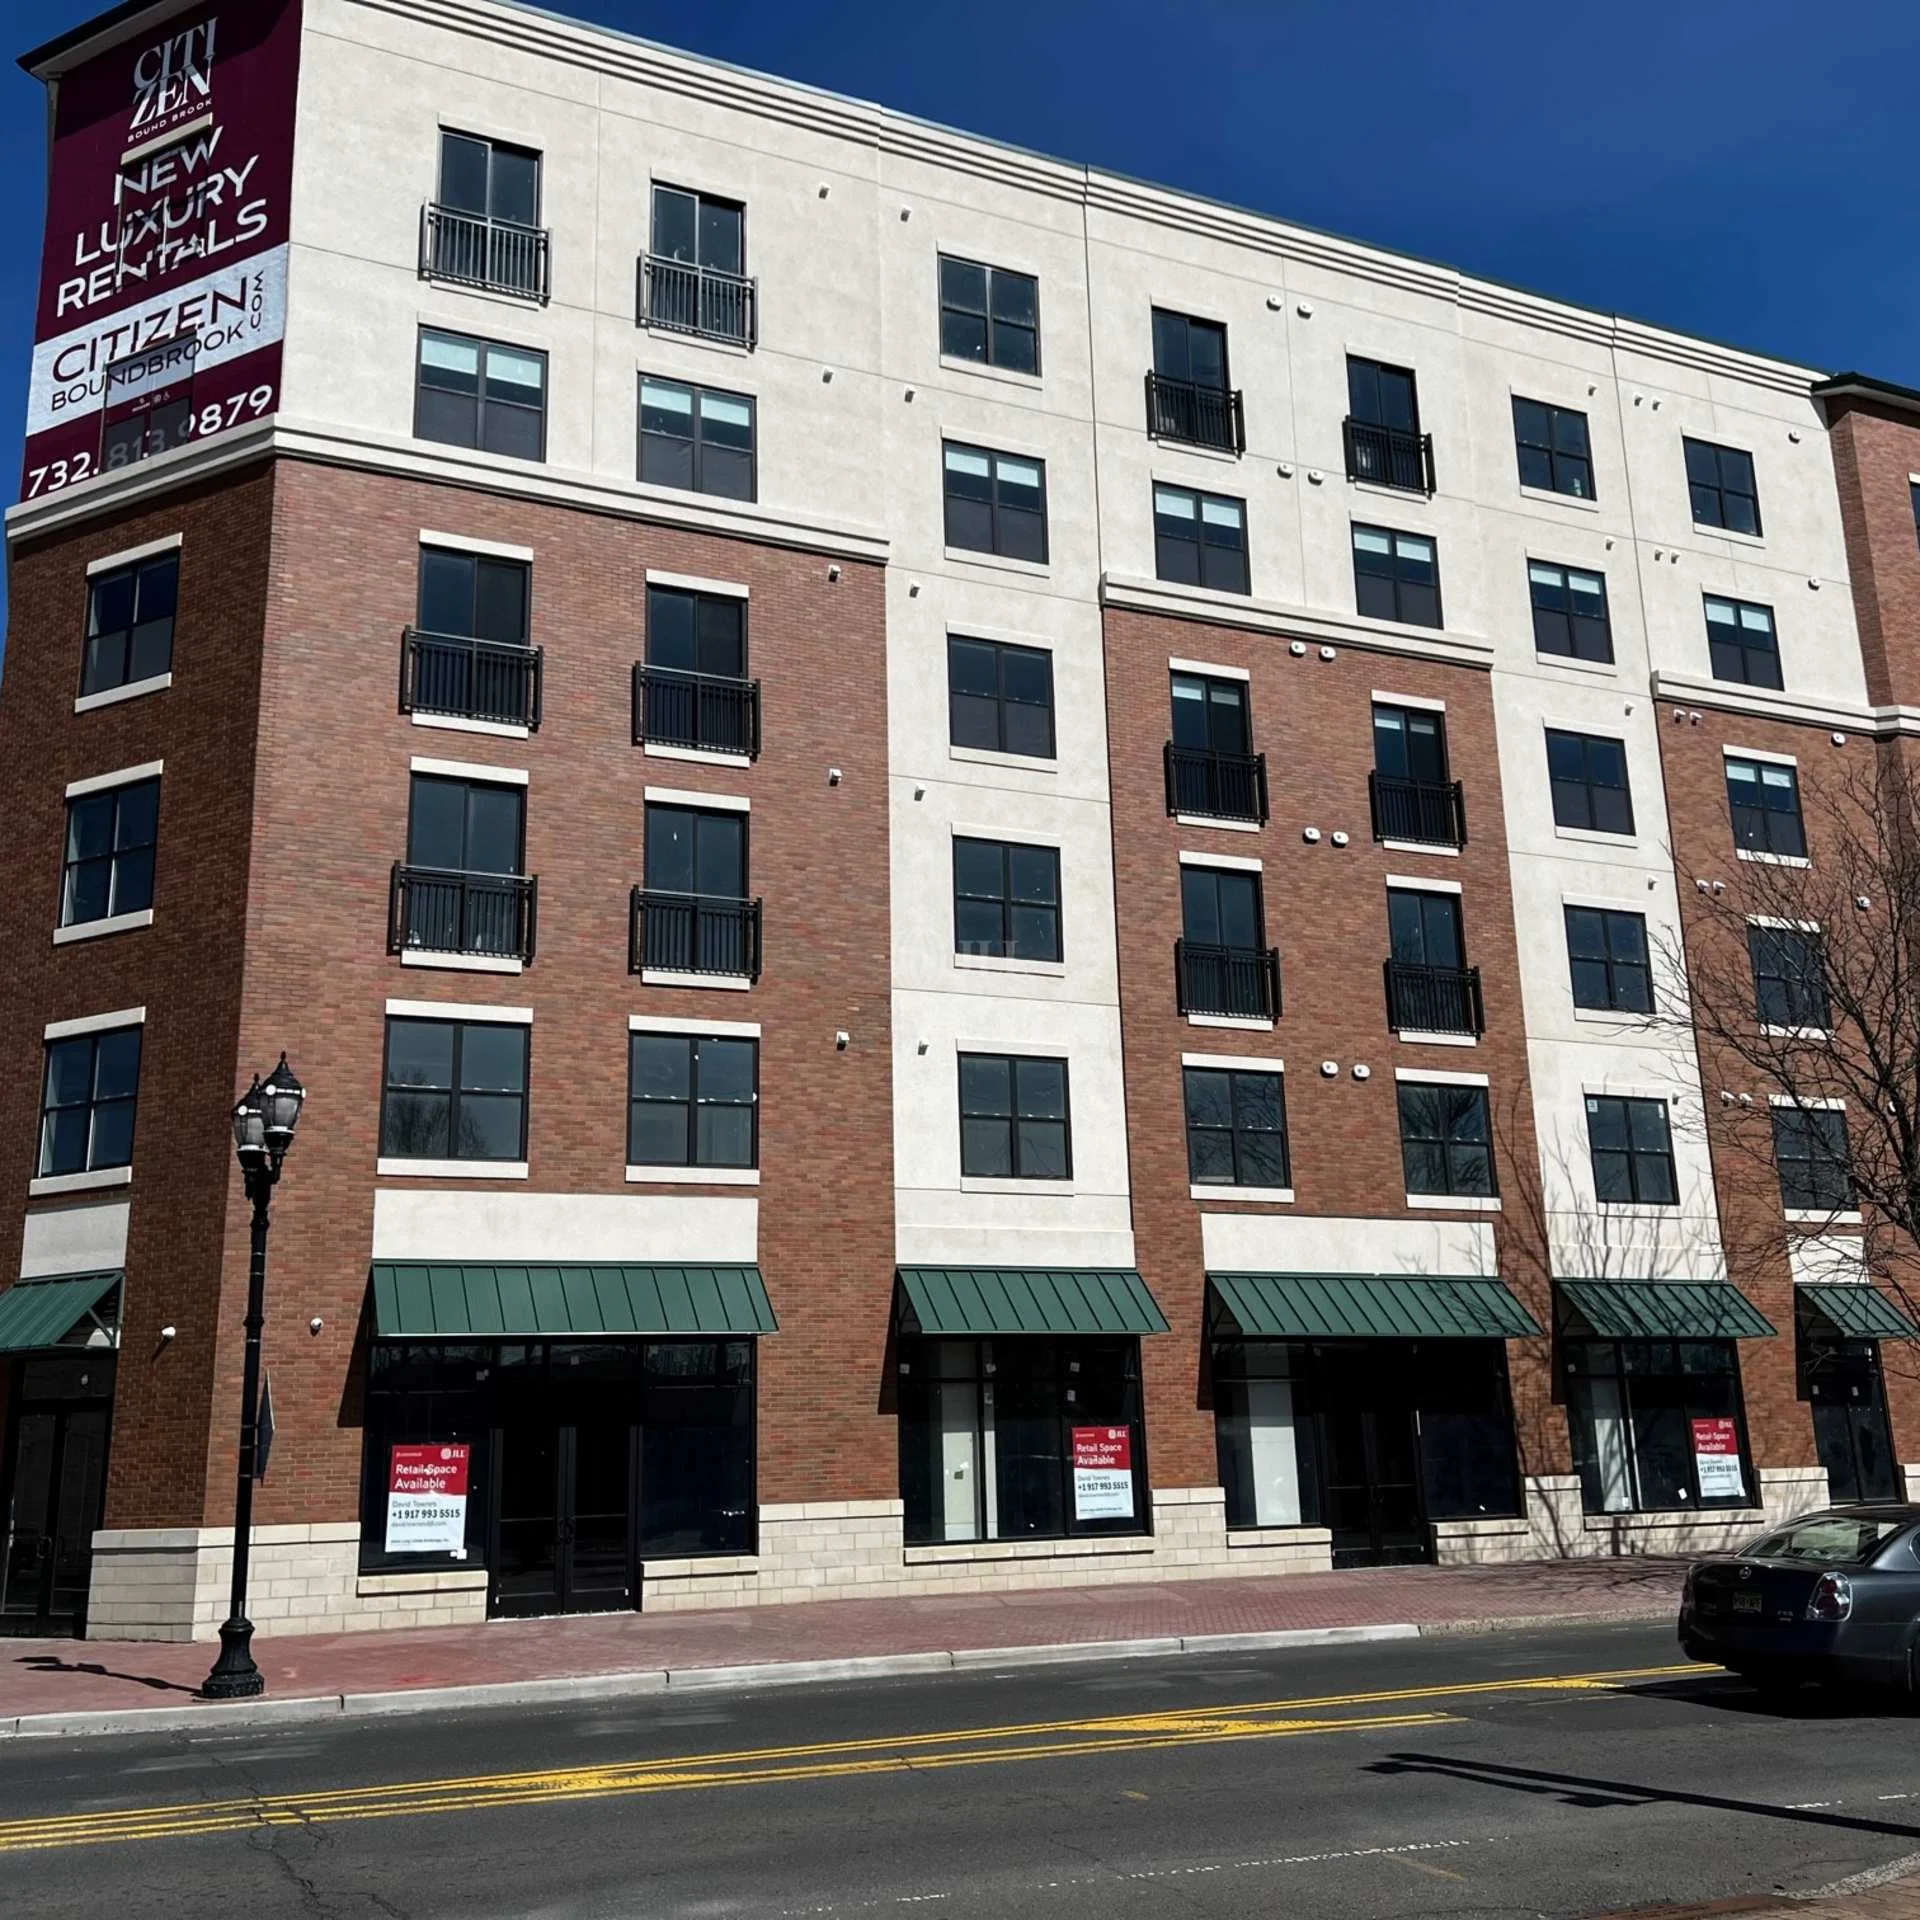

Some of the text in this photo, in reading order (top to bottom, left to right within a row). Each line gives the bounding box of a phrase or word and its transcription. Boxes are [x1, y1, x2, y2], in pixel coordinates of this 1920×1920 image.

[133, 17, 218, 89] CITI
[127, 99, 213, 143] BOUND BROOK
[129, 56, 212, 130] ZEN
[113, 125, 223, 206] NEW
[75, 155, 259, 266] LUXURY
[57, 199, 268, 318] RENTALS
[51, 320, 244, 411] BOUNDBROOK
[52, 276, 248, 383] CITIZEN
[395, 1477, 446, 1489] Available
[396, 1464, 457, 1476] Retail Space
[1076, 1443, 1122, 1453] Retail Space
[1077, 1455, 1115, 1465] Available
[405, 1510, 420, 1519] 917
[422, 1509, 437, 1519] 993
[440, 1508, 460, 1518] 5515
